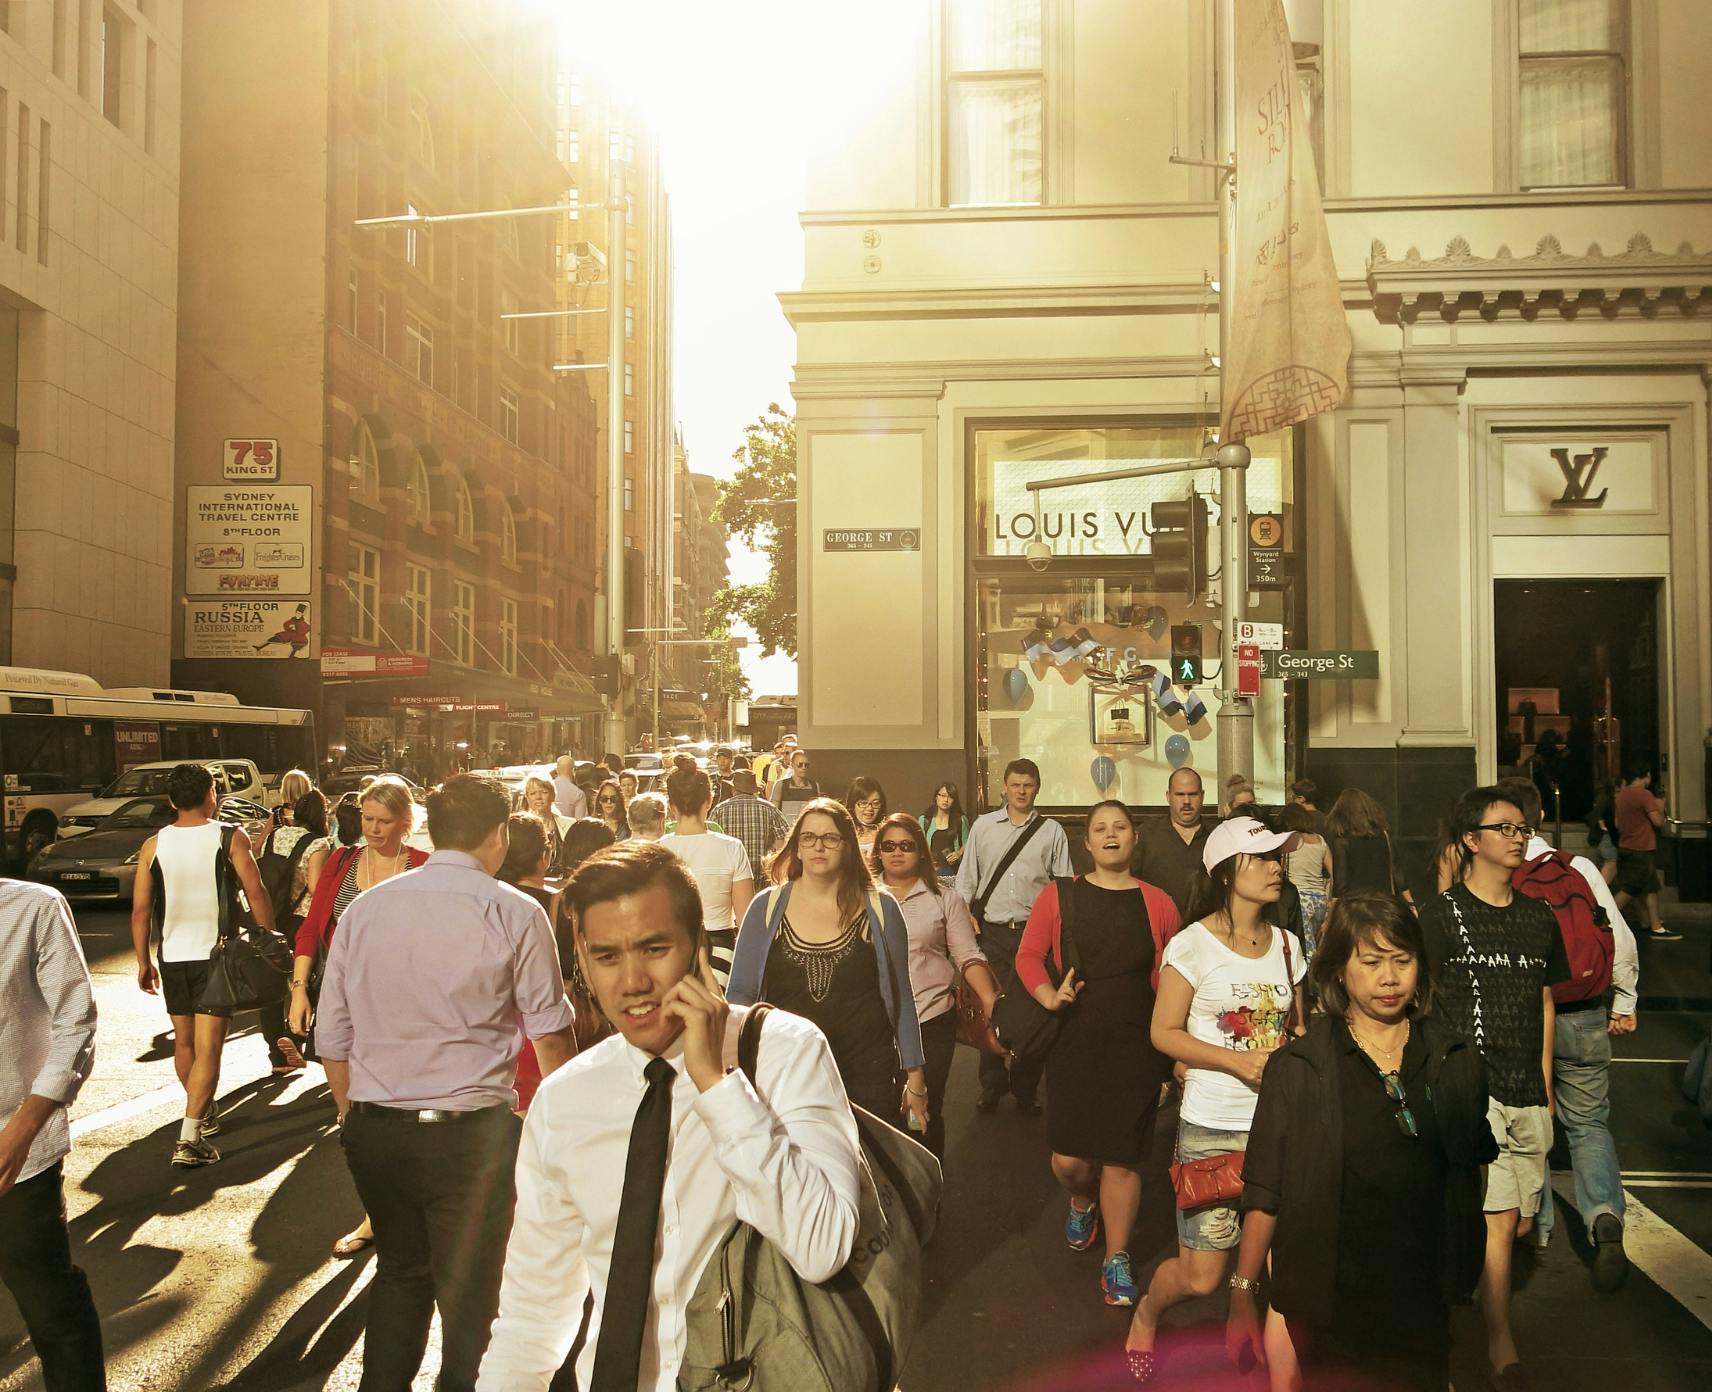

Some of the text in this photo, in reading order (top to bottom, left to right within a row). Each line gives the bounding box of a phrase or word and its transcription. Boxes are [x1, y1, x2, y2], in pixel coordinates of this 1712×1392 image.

[229, 441, 274, 465] 75
[226, 466, 258, 474] KING
[223, 493, 275, 501] SYDNEY
[199, 503, 300, 512] INTERNATIONAL
[199, 513, 300, 521] TRAVEL CENTRE
[995, 511, 1099, 540] LOUIS
[241, 528, 281, 536] FLOOR
[826, 532, 892, 543] GEORGE ST
[1253, 551, 1279, 559] Wynyard
[240, 603, 280, 611] FLOOR
[194, 611, 264, 623] RUSSIA
[194, 624, 265, 633] EASTERN EUROPE
[1244, 648, 1254, 657] NO
[1278, 654, 1355, 671] George St
[116, 731, 159, 743] UNLIMITED
